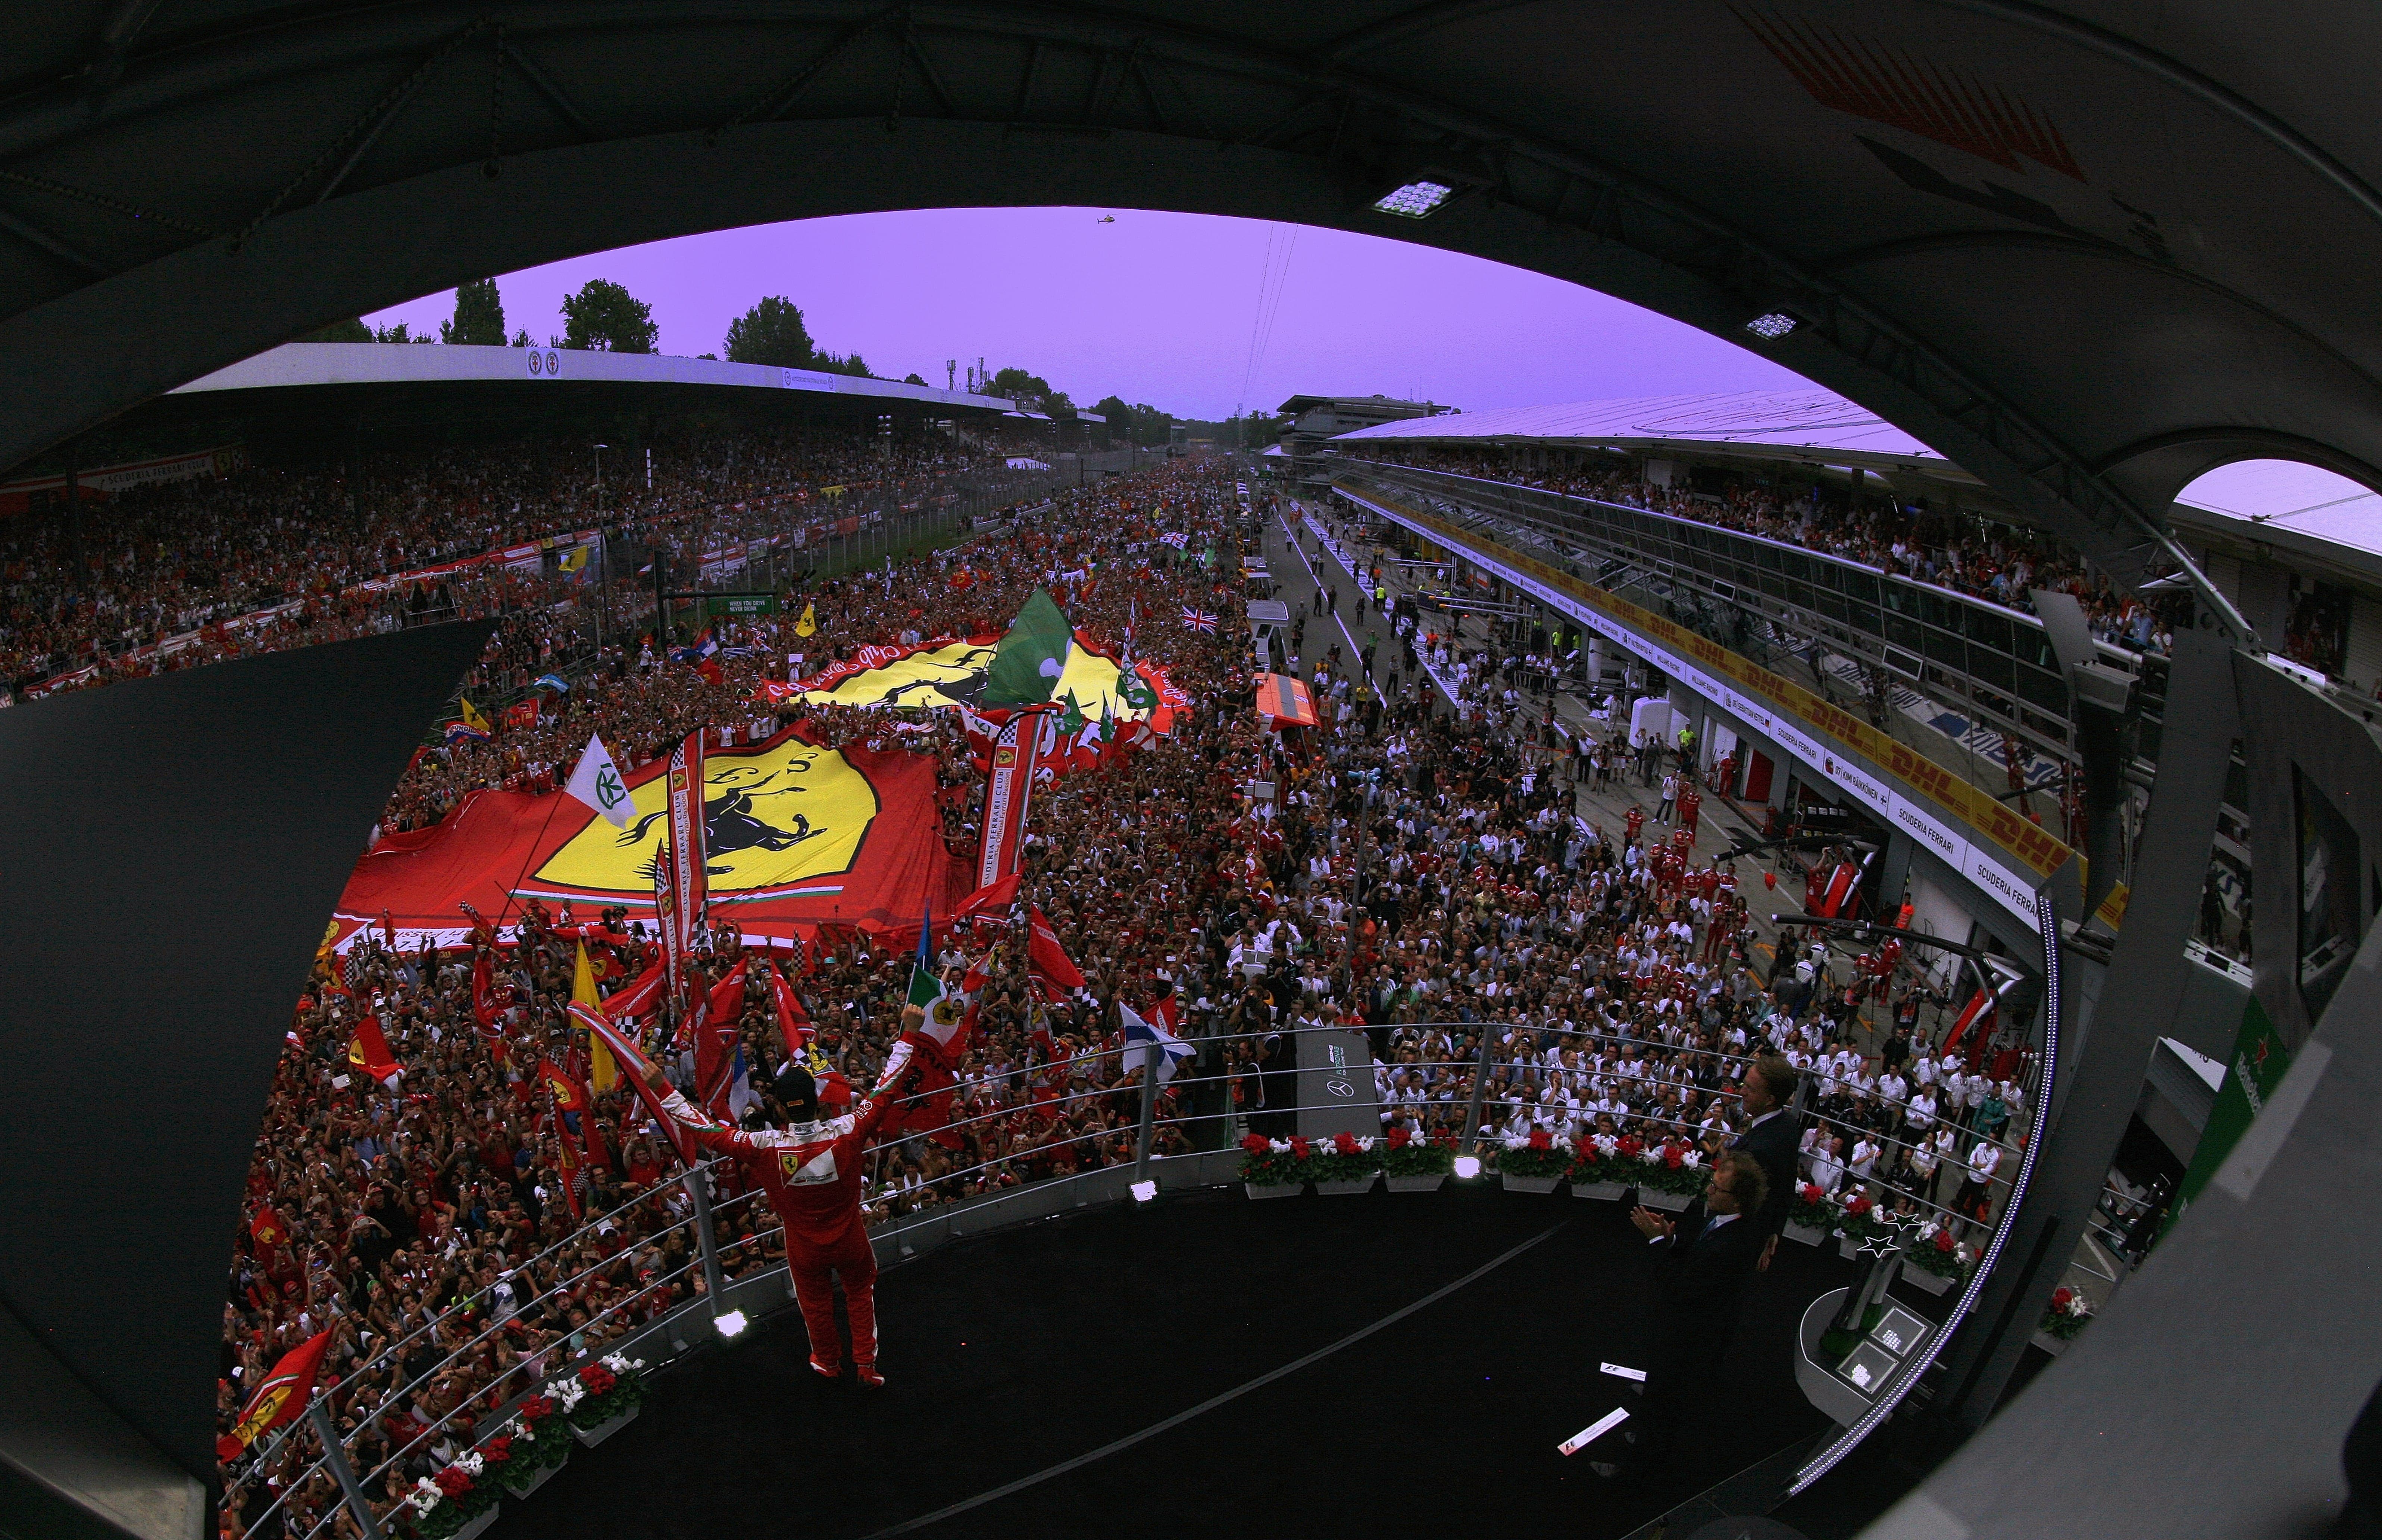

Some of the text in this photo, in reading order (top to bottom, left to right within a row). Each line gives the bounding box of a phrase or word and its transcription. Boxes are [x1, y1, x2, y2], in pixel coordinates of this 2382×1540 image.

[109, 459, 206, 484] SCUDERIA FERRARI CLUB
[1612, 598, 1640, 624] DHL
[1648, 616, 1682, 643] DHL
[859, 645, 901, 669] Club
[1692, 636, 1729, 670] DHL
[1692, 674, 1718, 696] WILLIAMS RACING
[1746, 663, 1788, 704] DHL
[1810, 698, 1863, 747] DHL
[1778, 727, 1817, 760] SCUDERIA FERRARI
[1002, 771, 1010, 796] Passion
[1835, 766, 1878, 801] 07 KIMI RÄIKKÖNEN
[1891, 744, 1955, 806] DHL
[990, 801, 1000, 839] FERRARI
[995, 771, 1004, 795] CLUB
[678, 824, 686, 864] FERRARI
[1898, 808, 1954, 854] SCUDERIA FERRARI
[1977, 864, 2011, 898] SCUDERIA
